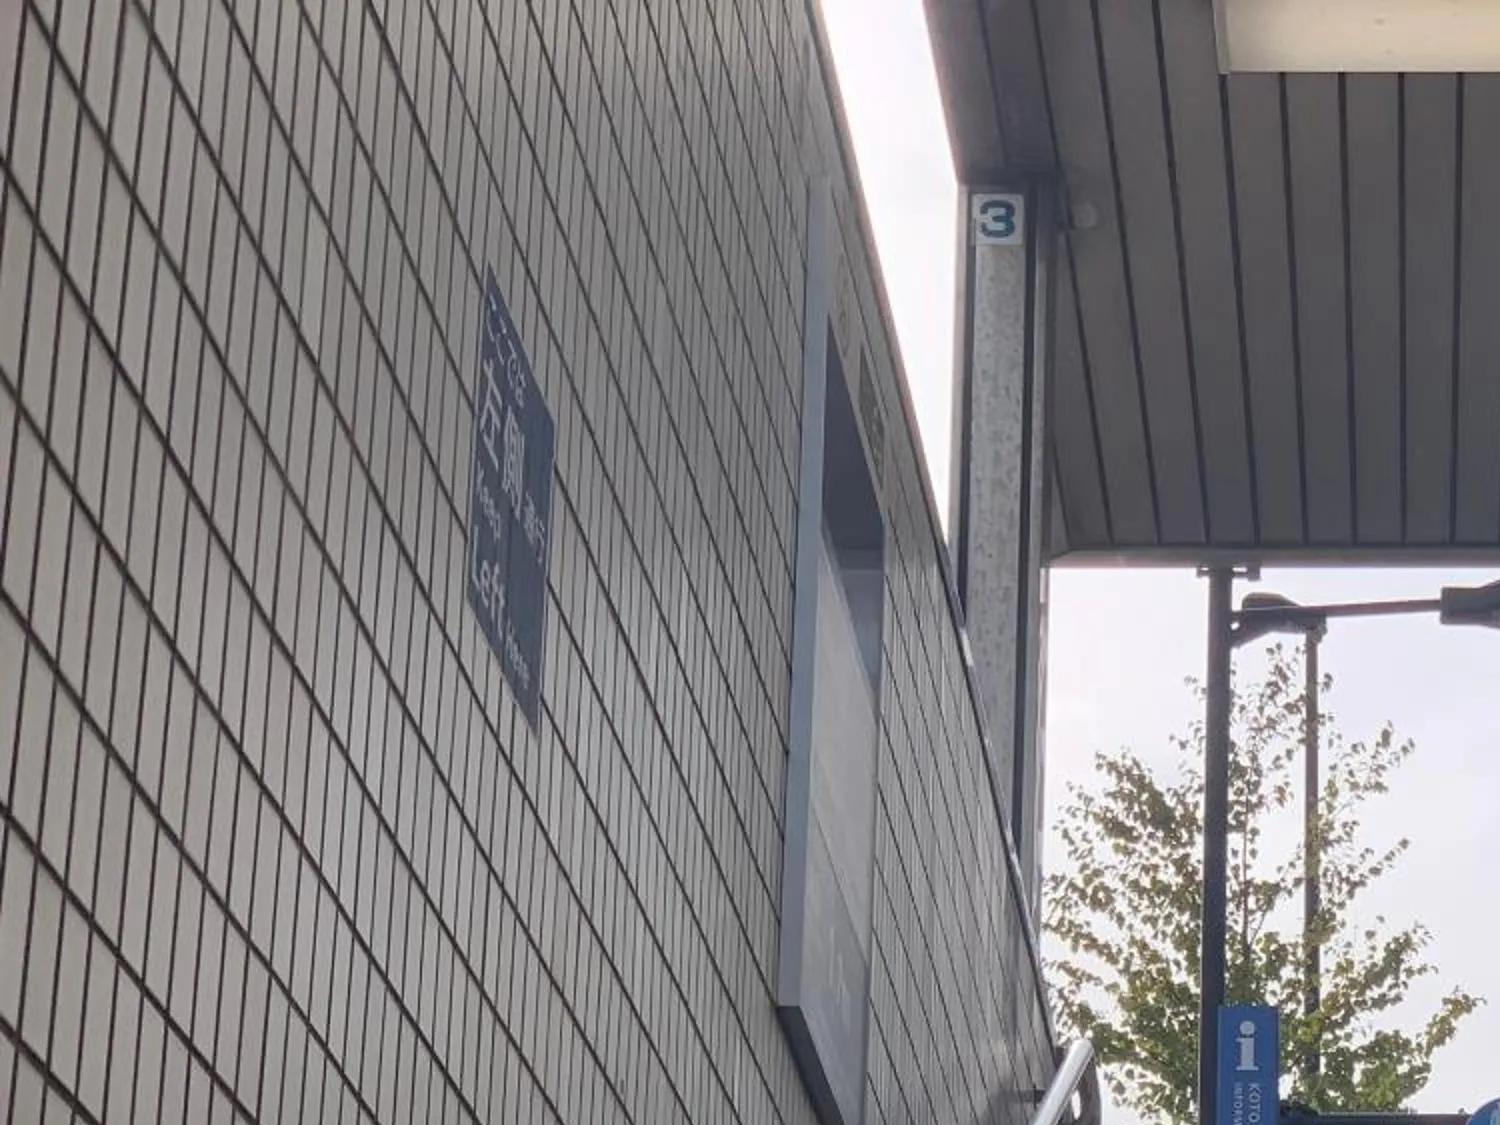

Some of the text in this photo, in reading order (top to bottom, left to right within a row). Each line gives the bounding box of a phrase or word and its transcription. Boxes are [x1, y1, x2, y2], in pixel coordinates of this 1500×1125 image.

[980, 199, 1015, 238] 3
[472, 524, 505, 640] Left
[1247, 1082, 1261, 1123] KOTO
